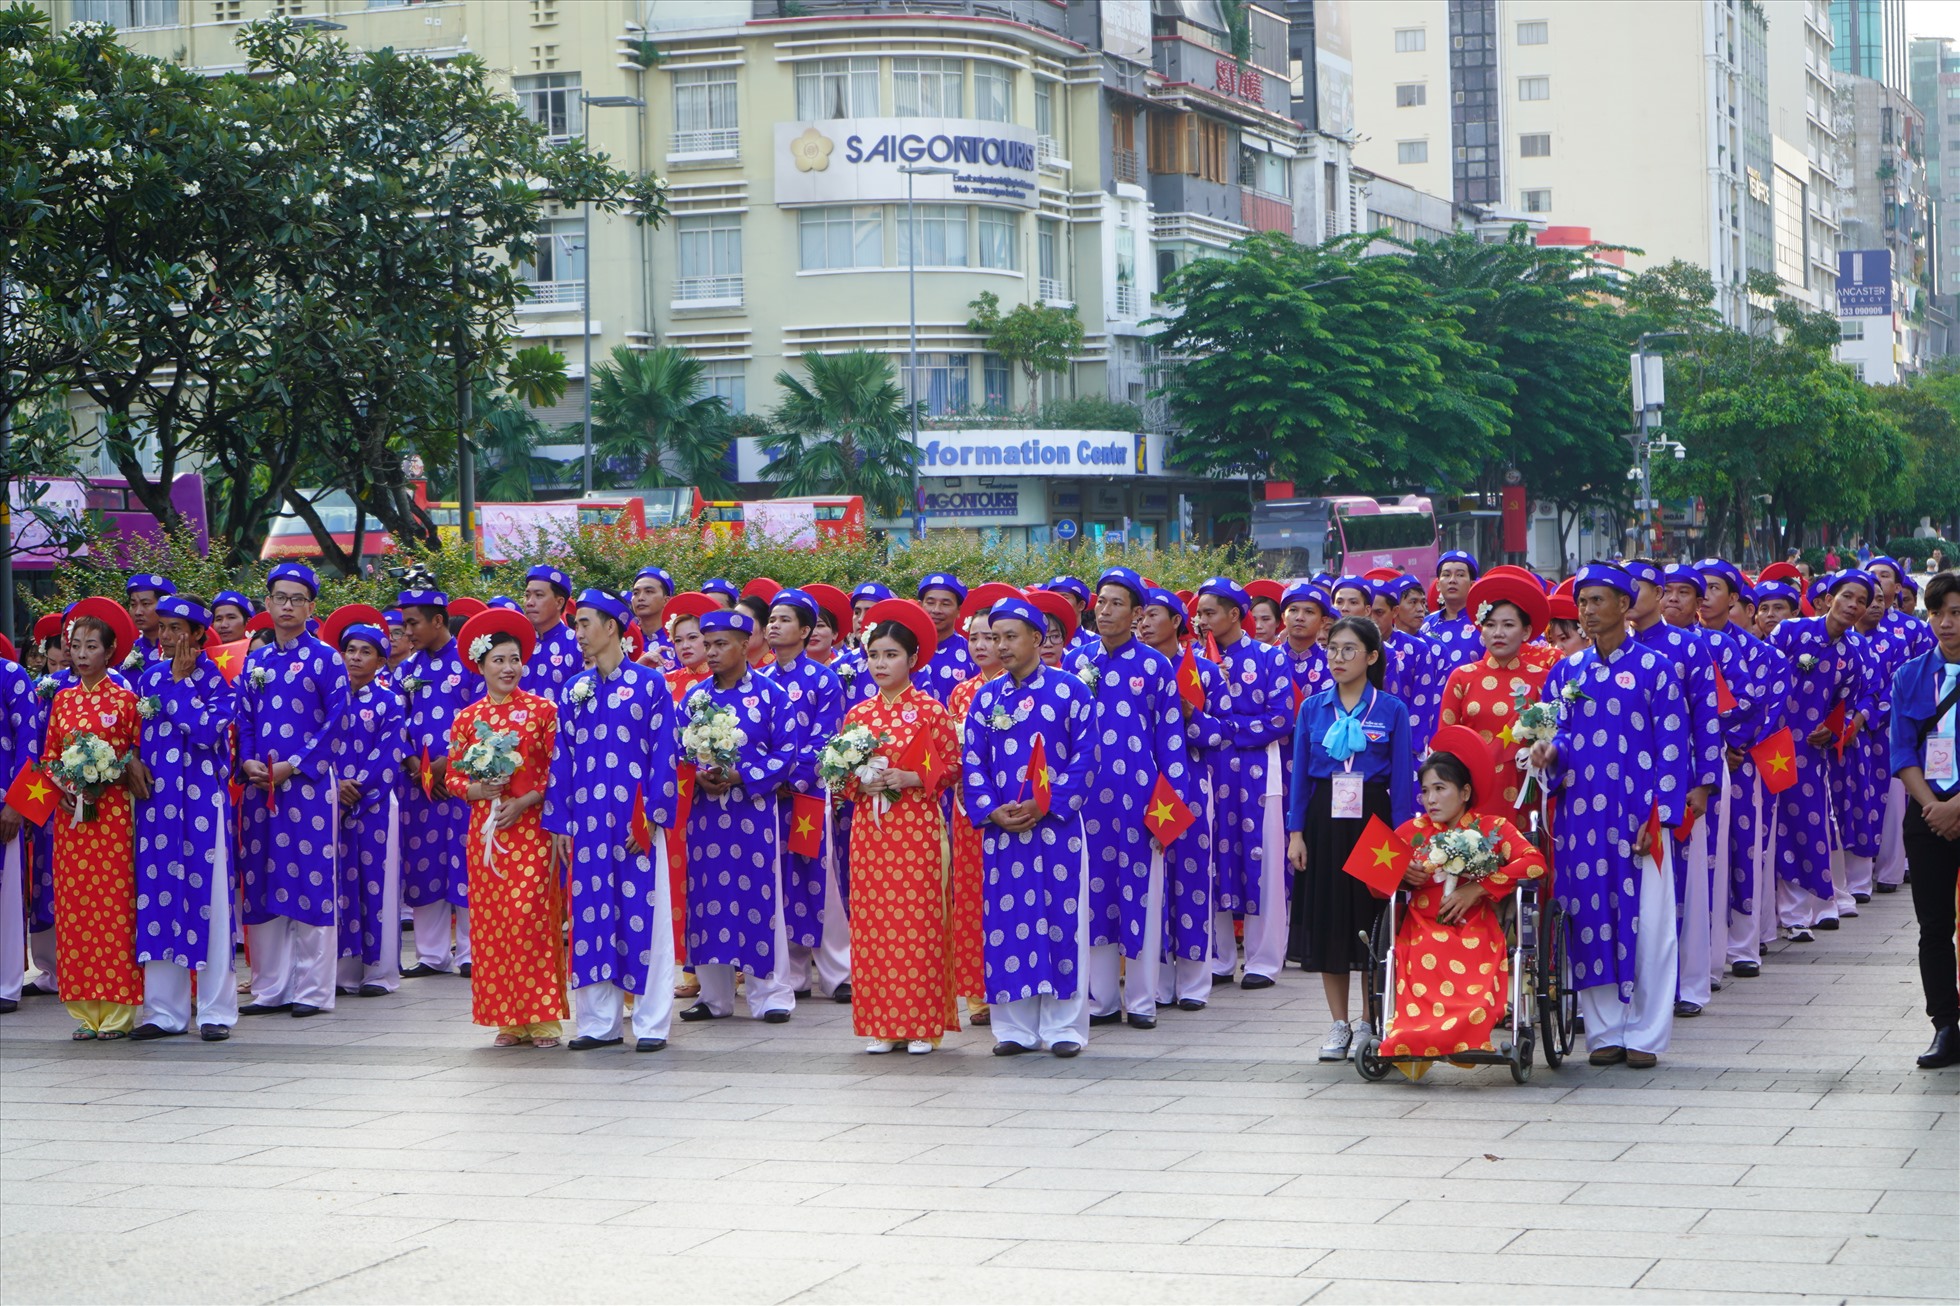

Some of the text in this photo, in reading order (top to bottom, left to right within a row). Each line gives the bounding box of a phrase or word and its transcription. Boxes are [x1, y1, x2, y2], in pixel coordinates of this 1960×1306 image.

[845, 133, 1036, 172] SAIGONTOURIST
[1836, 286, 1886, 296] ANCASTER
[1854, 306, 1883, 315] 090909
[1076, 439, 1129, 466] Center
[1132, 679, 1142, 687] 64
[1024, 699, 1033, 709] 63
[904, 712, 915, 720] 63
